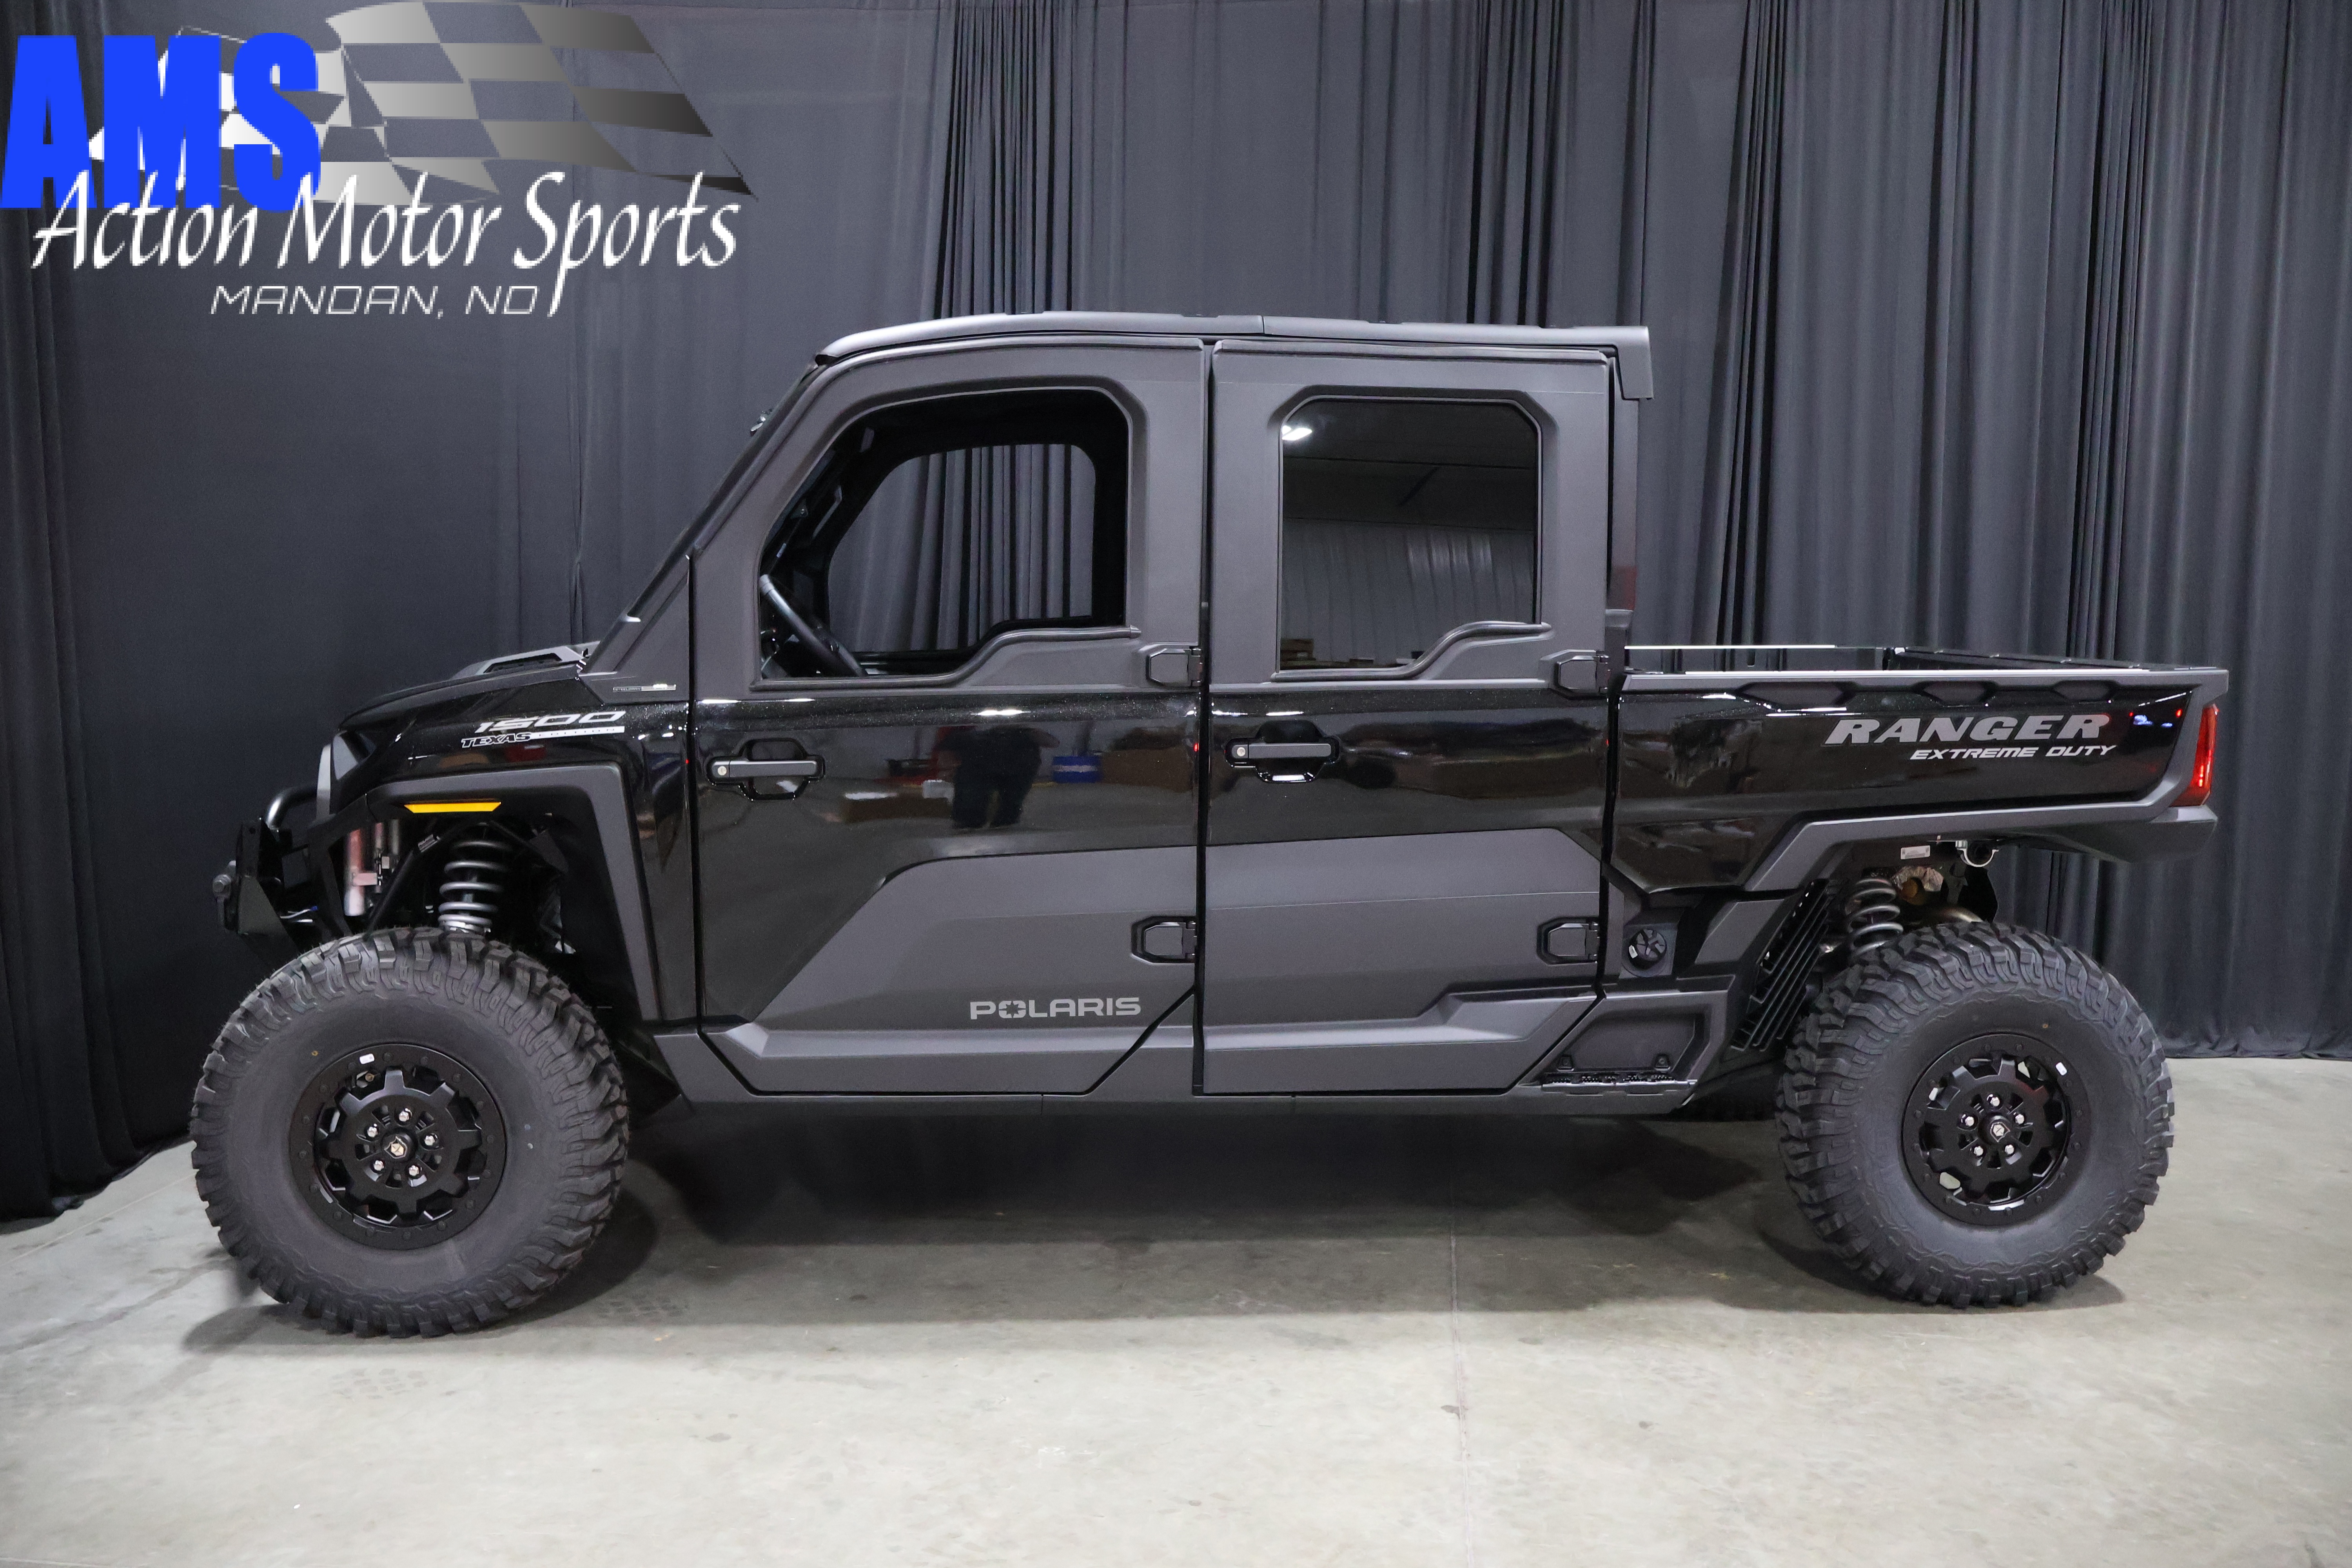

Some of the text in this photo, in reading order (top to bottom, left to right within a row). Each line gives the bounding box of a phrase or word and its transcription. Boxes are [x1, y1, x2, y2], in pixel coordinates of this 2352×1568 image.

[474, 711, 626, 733] 1500
[1824, 714, 2111, 744] RANGER
[461, 728, 615, 748] TEXAS EDITION
[1910, 745, 2117, 760] EXTREME DUTY
[970, 997, 1141, 1019] POLARIS
